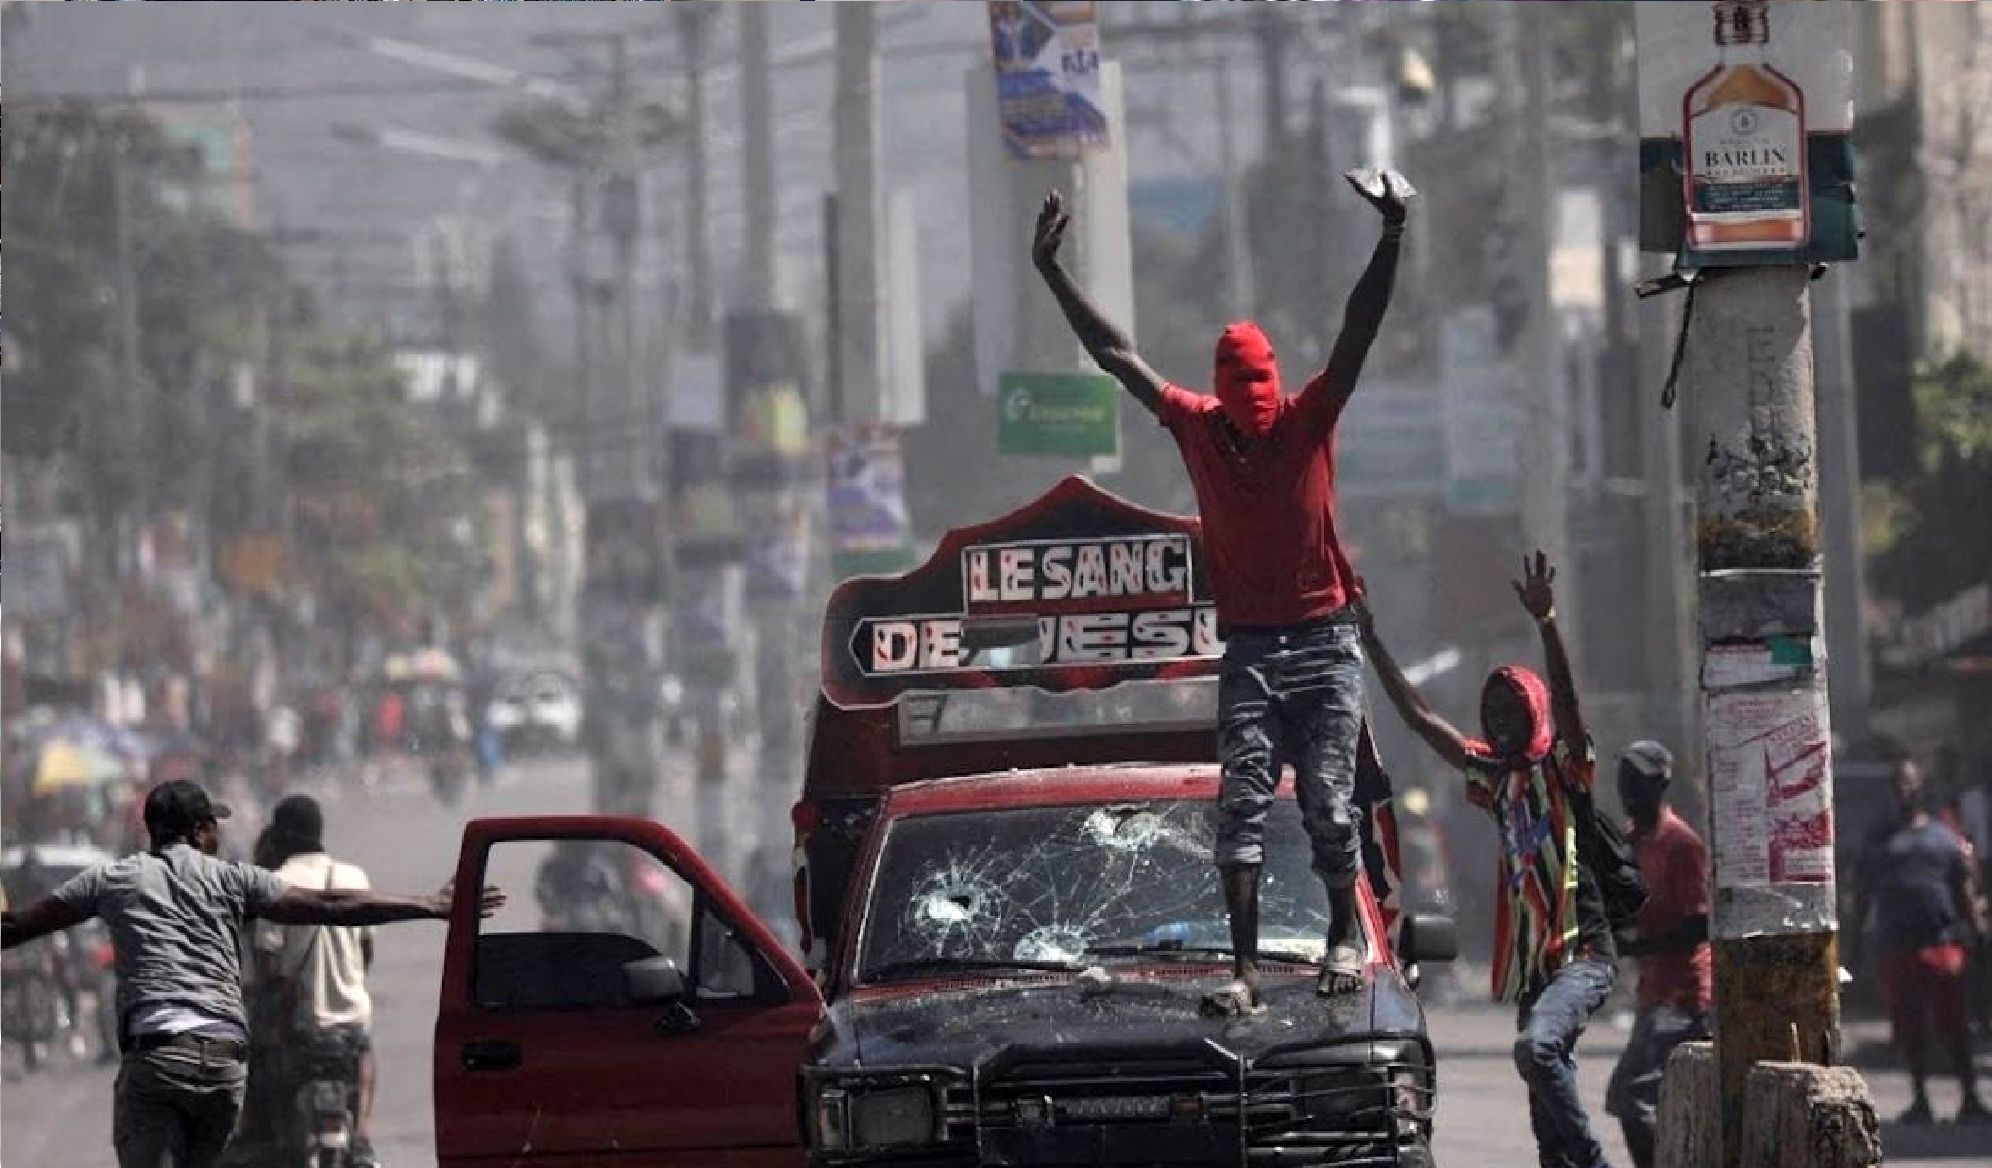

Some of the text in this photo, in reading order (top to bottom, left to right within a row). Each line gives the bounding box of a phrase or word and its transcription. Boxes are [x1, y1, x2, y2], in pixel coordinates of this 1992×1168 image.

[1705, 148, 1786, 168] BARLIN
[970, 541, 1187, 601] LE SANG
[873, 620, 961, 671] DE
